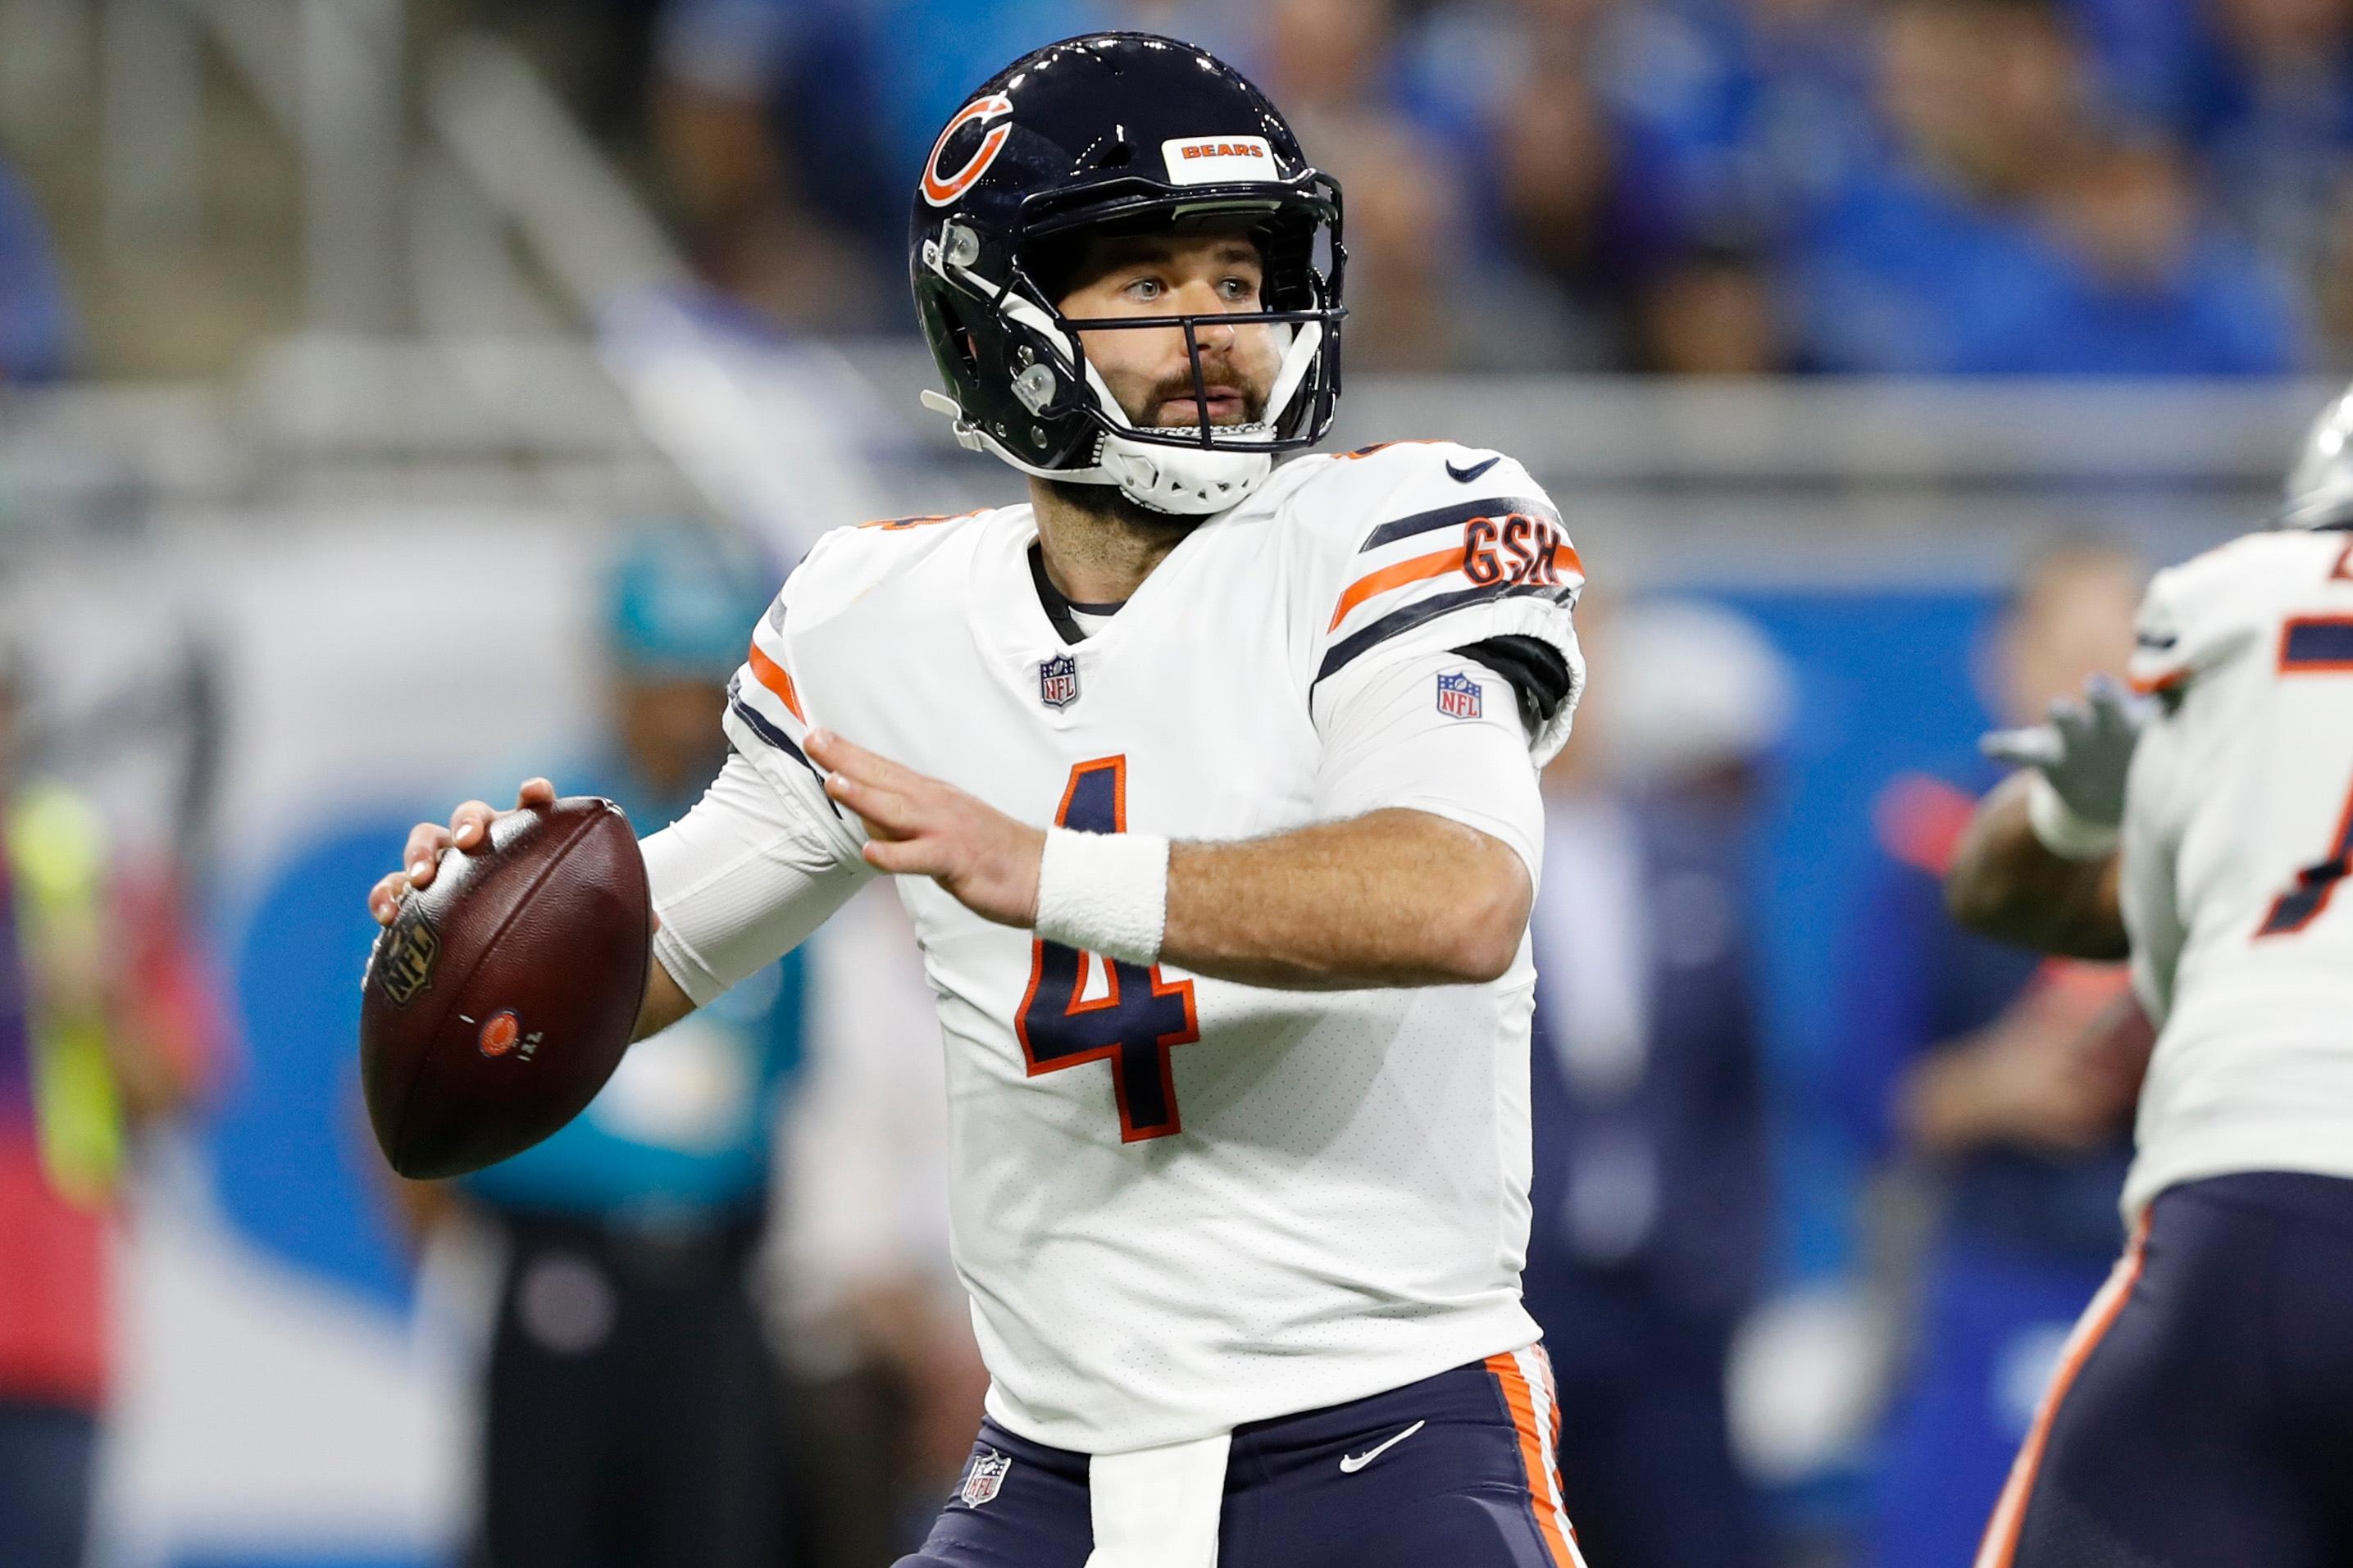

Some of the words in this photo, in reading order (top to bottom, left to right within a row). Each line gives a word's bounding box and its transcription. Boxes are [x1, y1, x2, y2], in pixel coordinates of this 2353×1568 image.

[1181, 143, 1263, 160] BEARS
[1463, 514, 1563, 587] GSH
[1045, 676, 1075, 702] NFL
[1440, 690, 1478, 718] NFL
[385, 923, 435, 1002] NFL
[1015, 753, 1199, 1143] 4
